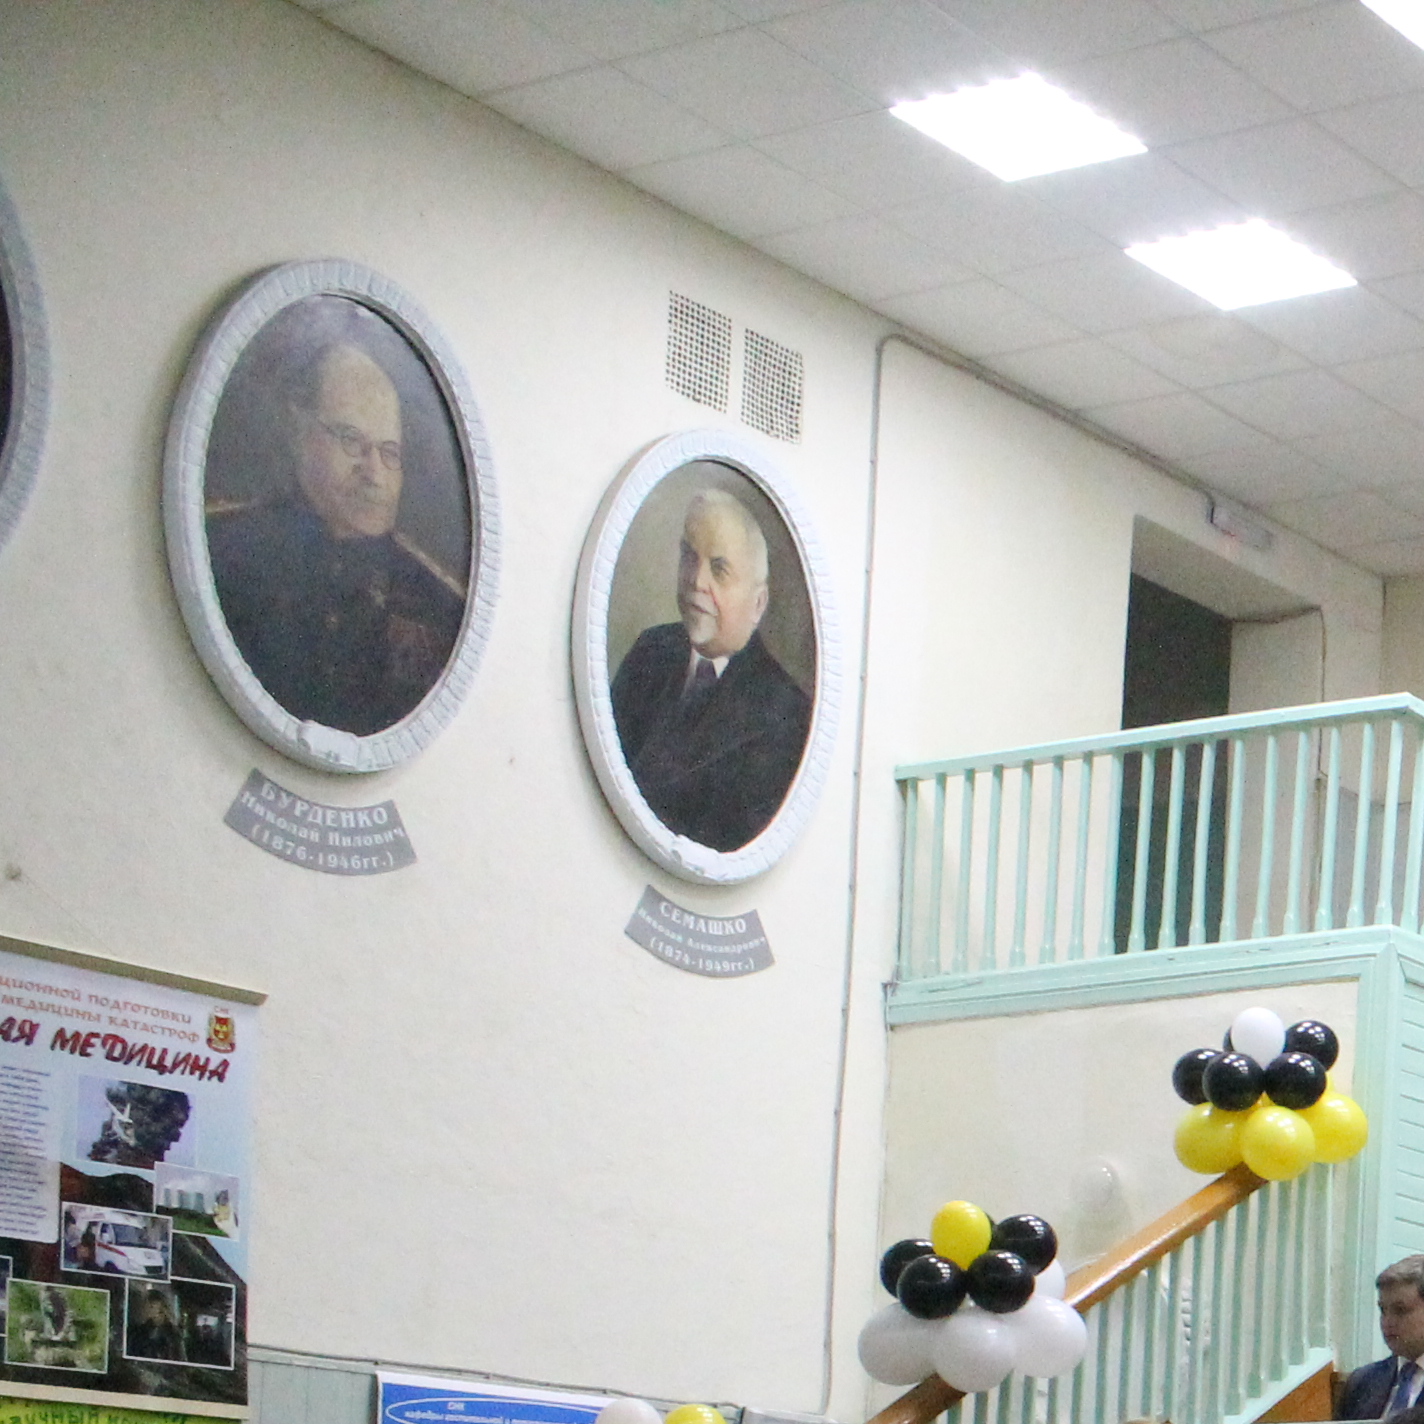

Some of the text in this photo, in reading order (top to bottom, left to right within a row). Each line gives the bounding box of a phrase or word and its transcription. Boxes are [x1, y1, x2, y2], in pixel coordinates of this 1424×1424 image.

[241, 790, 320, 843] Николай
[261, 782, 388, 829] БУРДЕНКО
[660, 901, 747, 936] СЕМАШКО
[1, 994, 200, 1043] МЕДИЦИНЫ КАТАСТРОФ
[88, 993, 192, 1025] ПОДГОТОВКИ
[50, 1027, 231, 1083] МЕДИЦИНА
